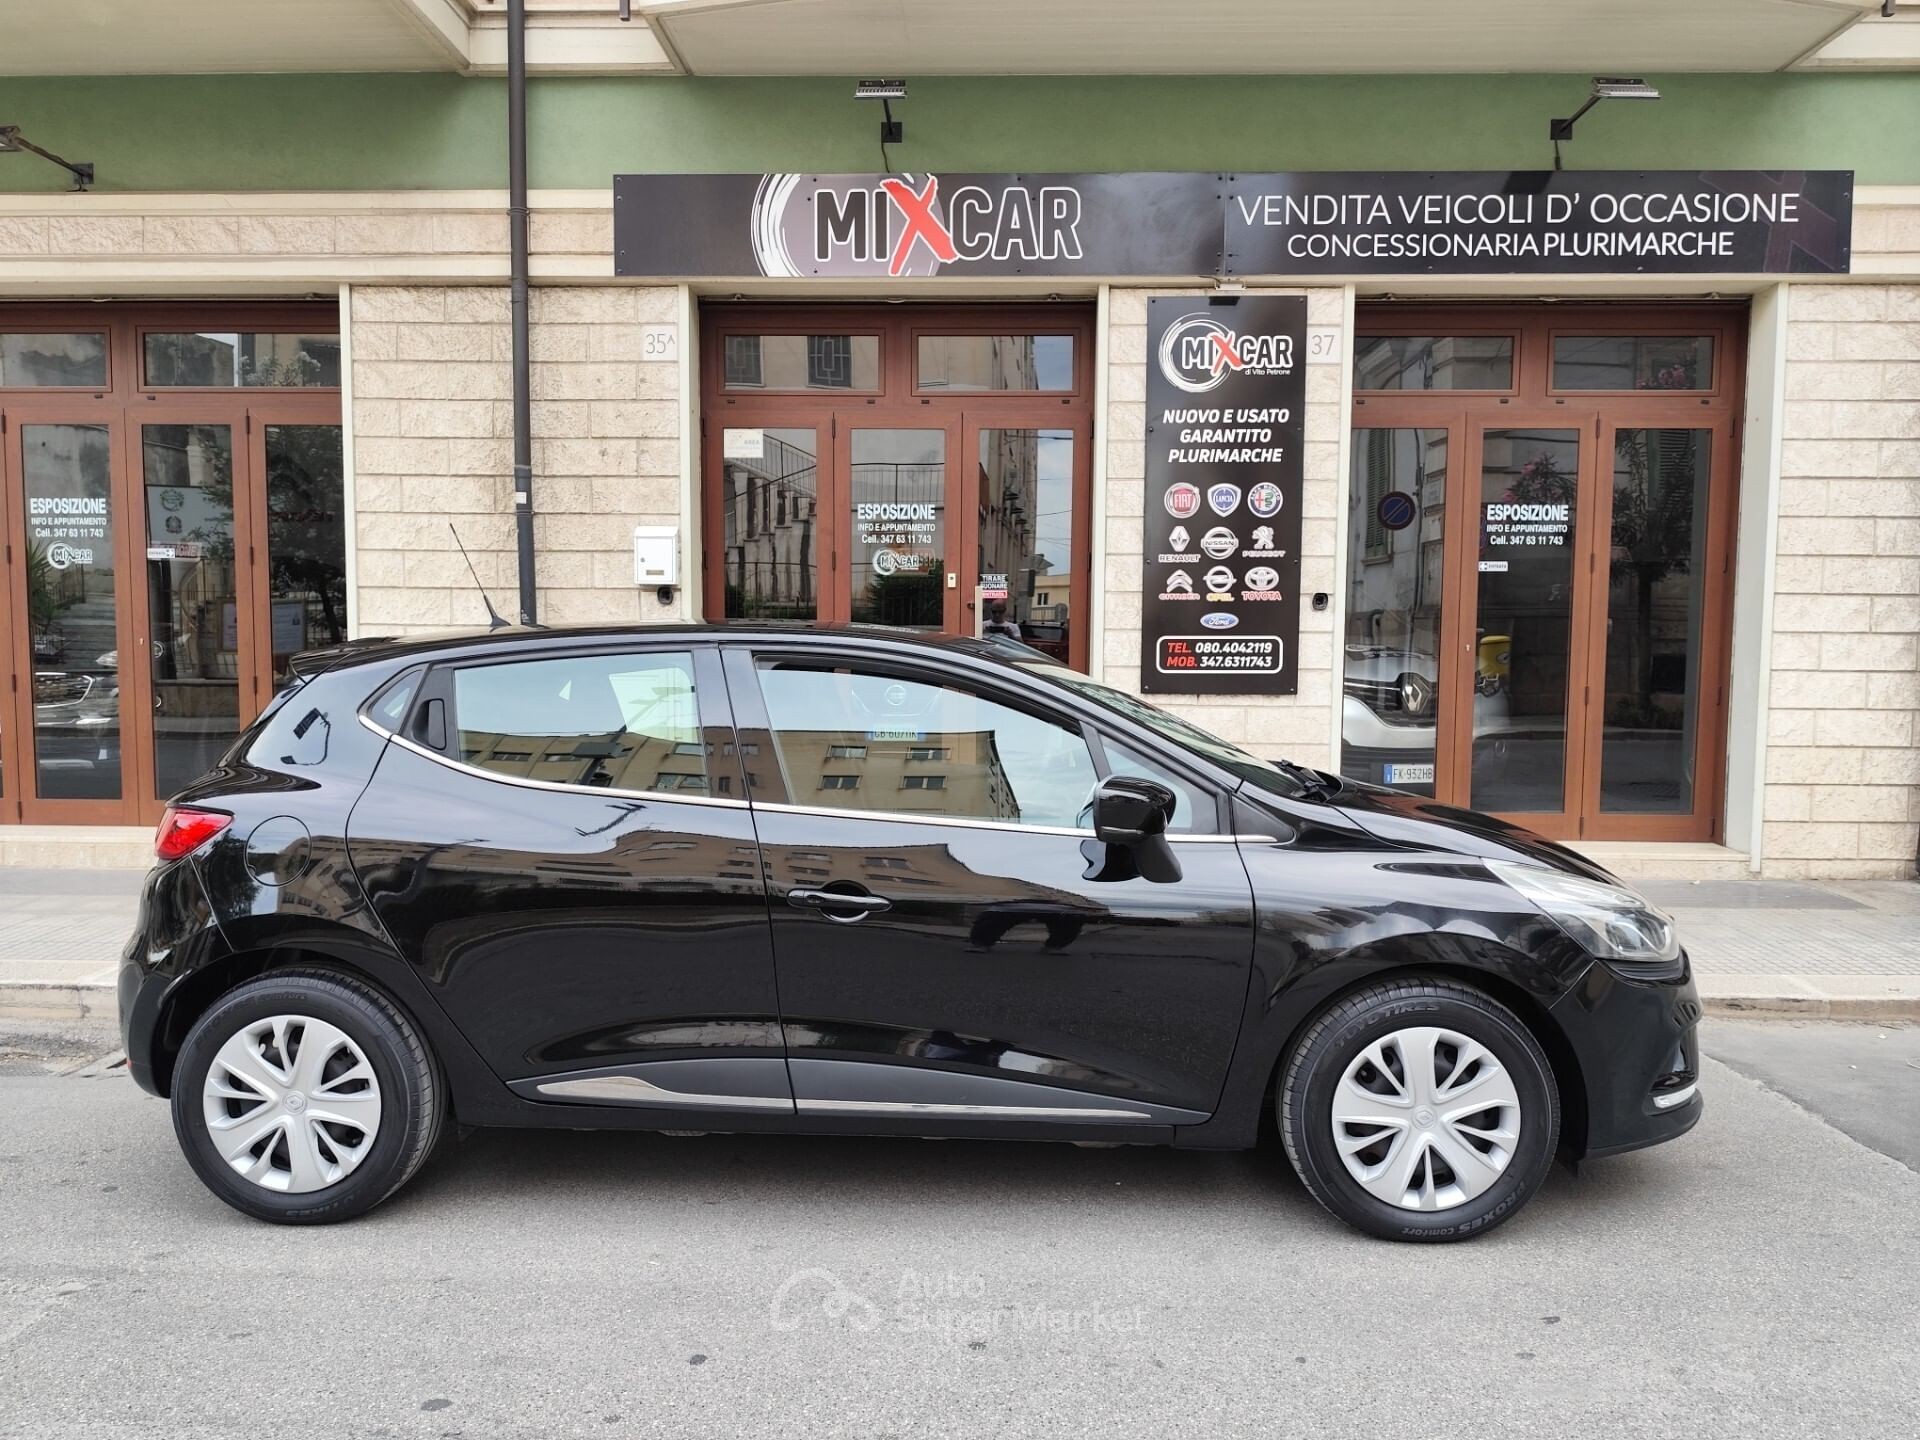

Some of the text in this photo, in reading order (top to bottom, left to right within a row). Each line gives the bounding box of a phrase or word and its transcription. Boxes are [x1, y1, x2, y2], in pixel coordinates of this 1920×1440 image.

[1237, 195, 1392, 225] VENDITA
[1398, 194, 1532, 224] VEICOLI
[1590, 193, 1799, 223] OCCASIONE
[813, 176, 1083, 276] MIXCAR
[1287, 232, 1734, 257] CONCESSIONARIA PLURIMARCHE
[1311, 334, 1335, 356] 37
[1182, 331, 1293, 376] MIXCAR
[1163, 409, 1289, 423] NUOVO E USATO
[1180, 429, 1272, 443] GARANTITO
[1168, 448, 1283, 462] PLURIMARCHE
[30, 498, 107, 514] ESPOSIZIONE
[1174, 494, 1192, 508] FIAT
[857, 504, 936, 520] ESPOSIZIONE
[1486, 504, 1569, 521] ESPOSIZIONE
[31, 517, 107, 525] INFO E APPUNTAMENTO
[858, 523, 936, 531] INFO E APPUNTAMENTO
[35, 528, 104, 537] Cell. 347 63 11 743
[1486, 524, 1568, 533] INFO E APPUNTAMENTO
[862, 534, 932, 543] Cell. 347 63 11 743
[1490, 535, 1563, 545] Cell. 347 63 11 743
[1159, 554, 1201, 562] RENAULT
[1241, 591, 1282, 601] TOYOTA
[1209, 617, 1231, 625] Ford
[1167, 643, 1272, 653] TEL. 080.4042119
[1166, 656, 1272, 667] MOB. 347.6311743
[1385, 1001, 1441, 1017] TIRES
